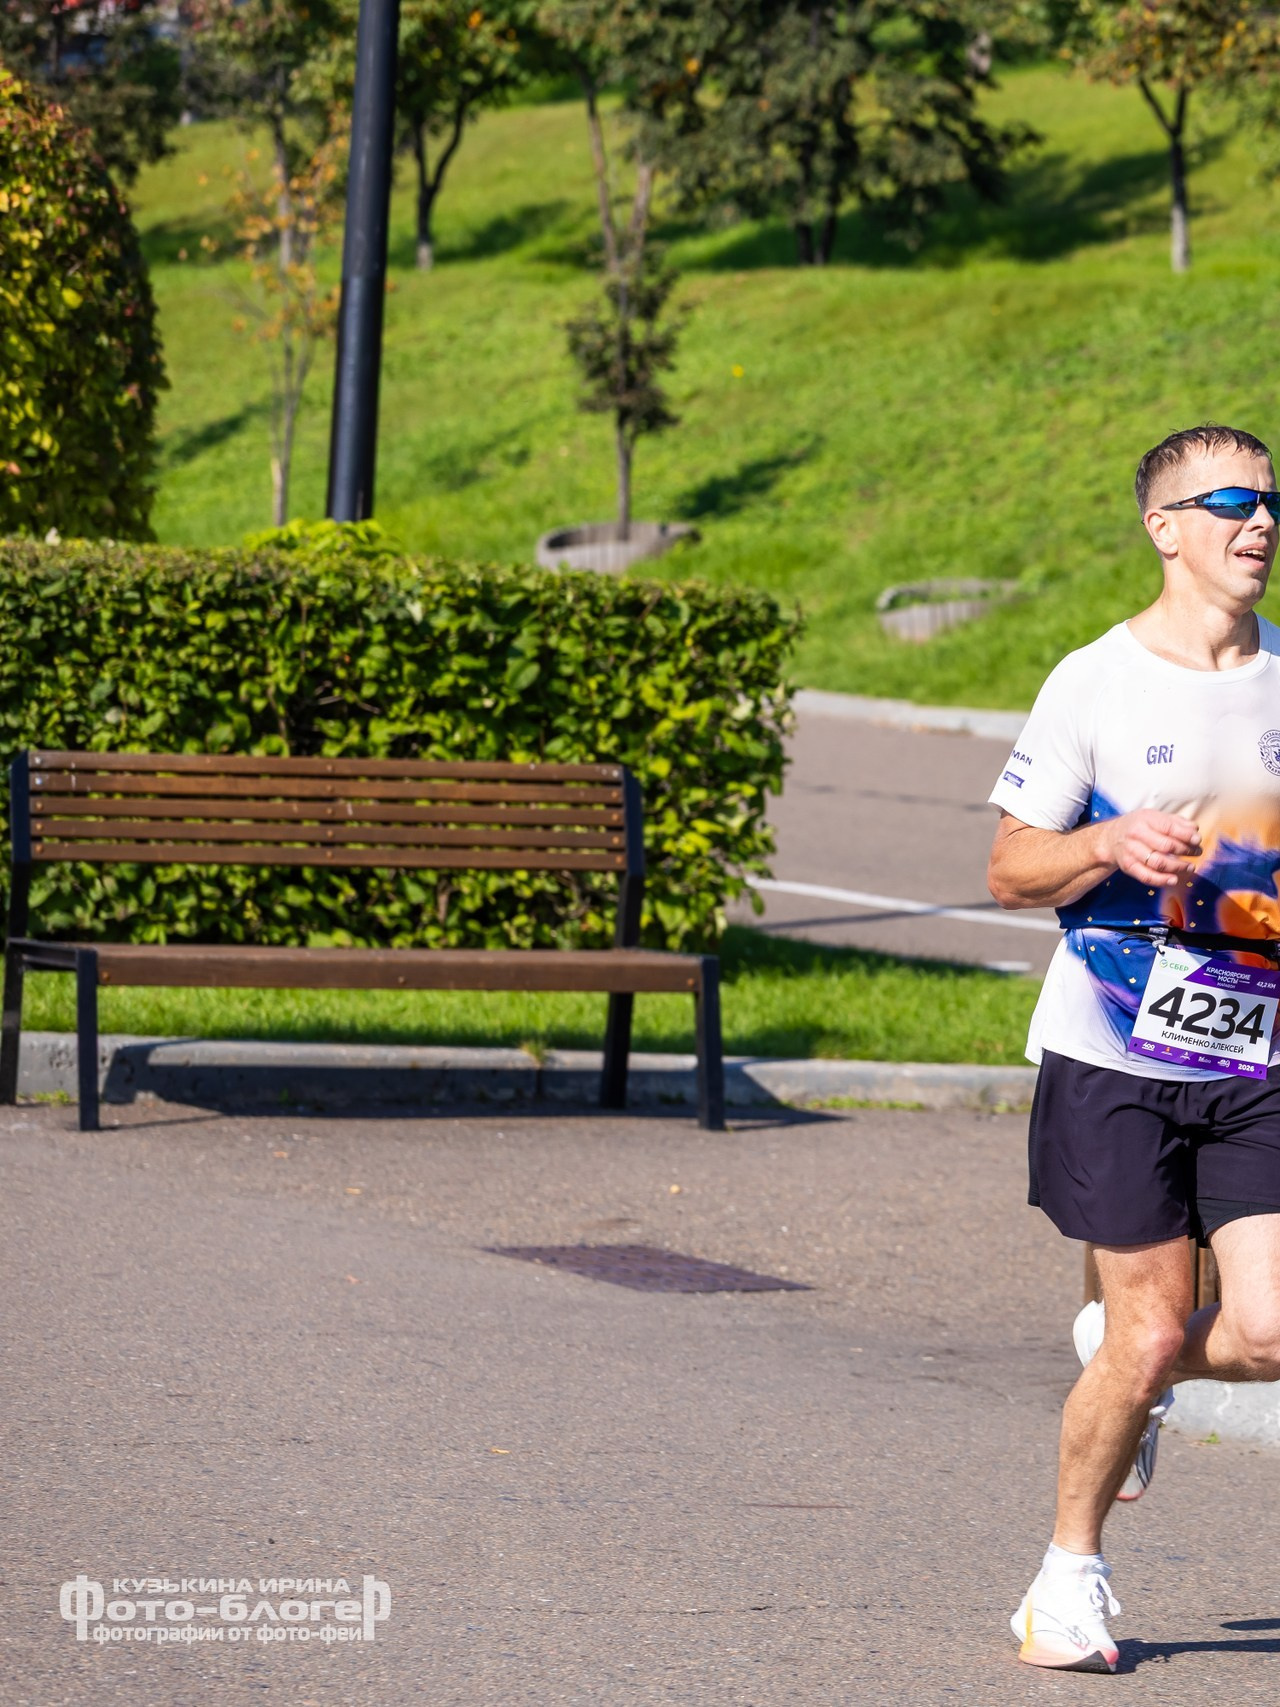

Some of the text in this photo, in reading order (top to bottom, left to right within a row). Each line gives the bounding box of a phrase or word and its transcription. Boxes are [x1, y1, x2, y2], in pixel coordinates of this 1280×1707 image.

[1169, 962, 1190, 972] СБЕР
[1206, 966, 1251, 981] КРАСНОЯРСКИЕ
[1217, 975, 1239, 985] МОСТЫ
[1148, 986, 1266, 1045] 4234
[1161, 1030, 1245, 1054] КЛИМЕНКО АЛЕКСЕЙ
